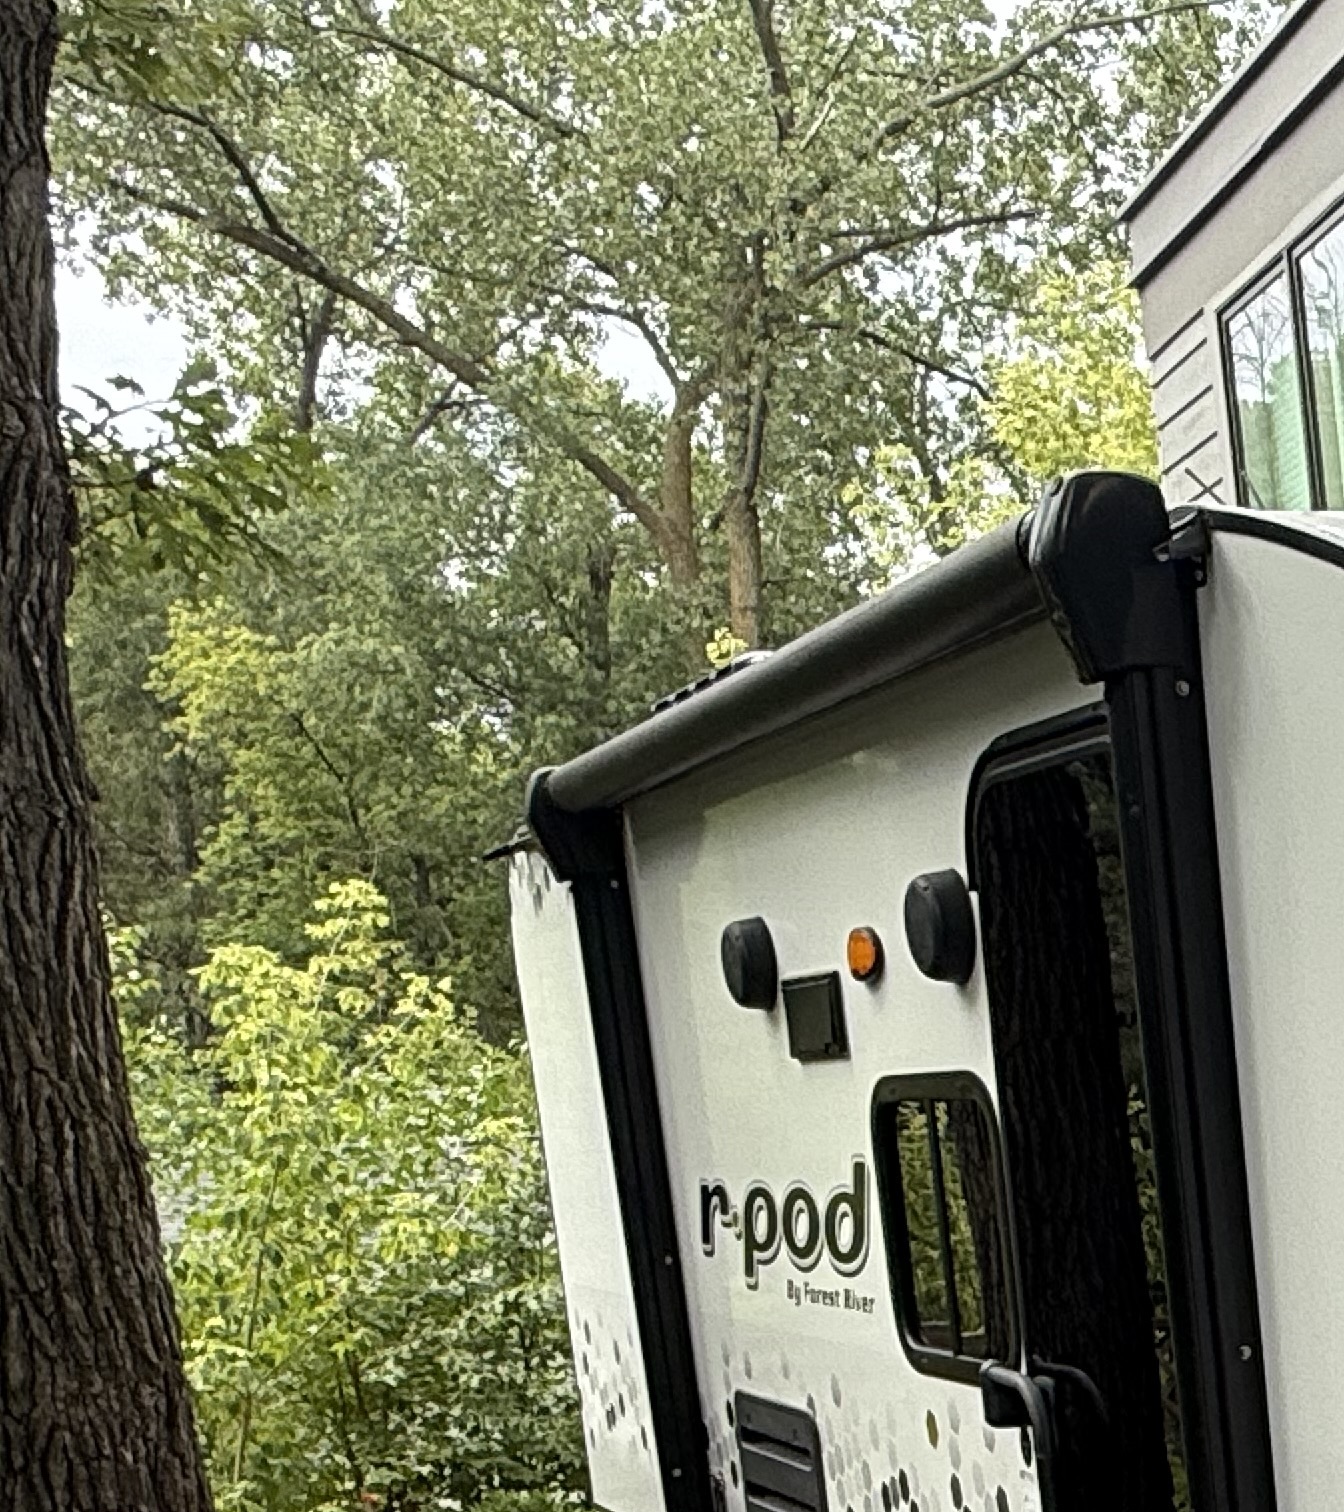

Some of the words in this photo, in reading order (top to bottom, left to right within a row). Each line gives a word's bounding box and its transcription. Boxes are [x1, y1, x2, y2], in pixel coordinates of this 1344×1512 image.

[786, 1278, 801, 1307] By
[803, 1281, 841, 1309] Forest
[843, 1287, 876, 1314] River
